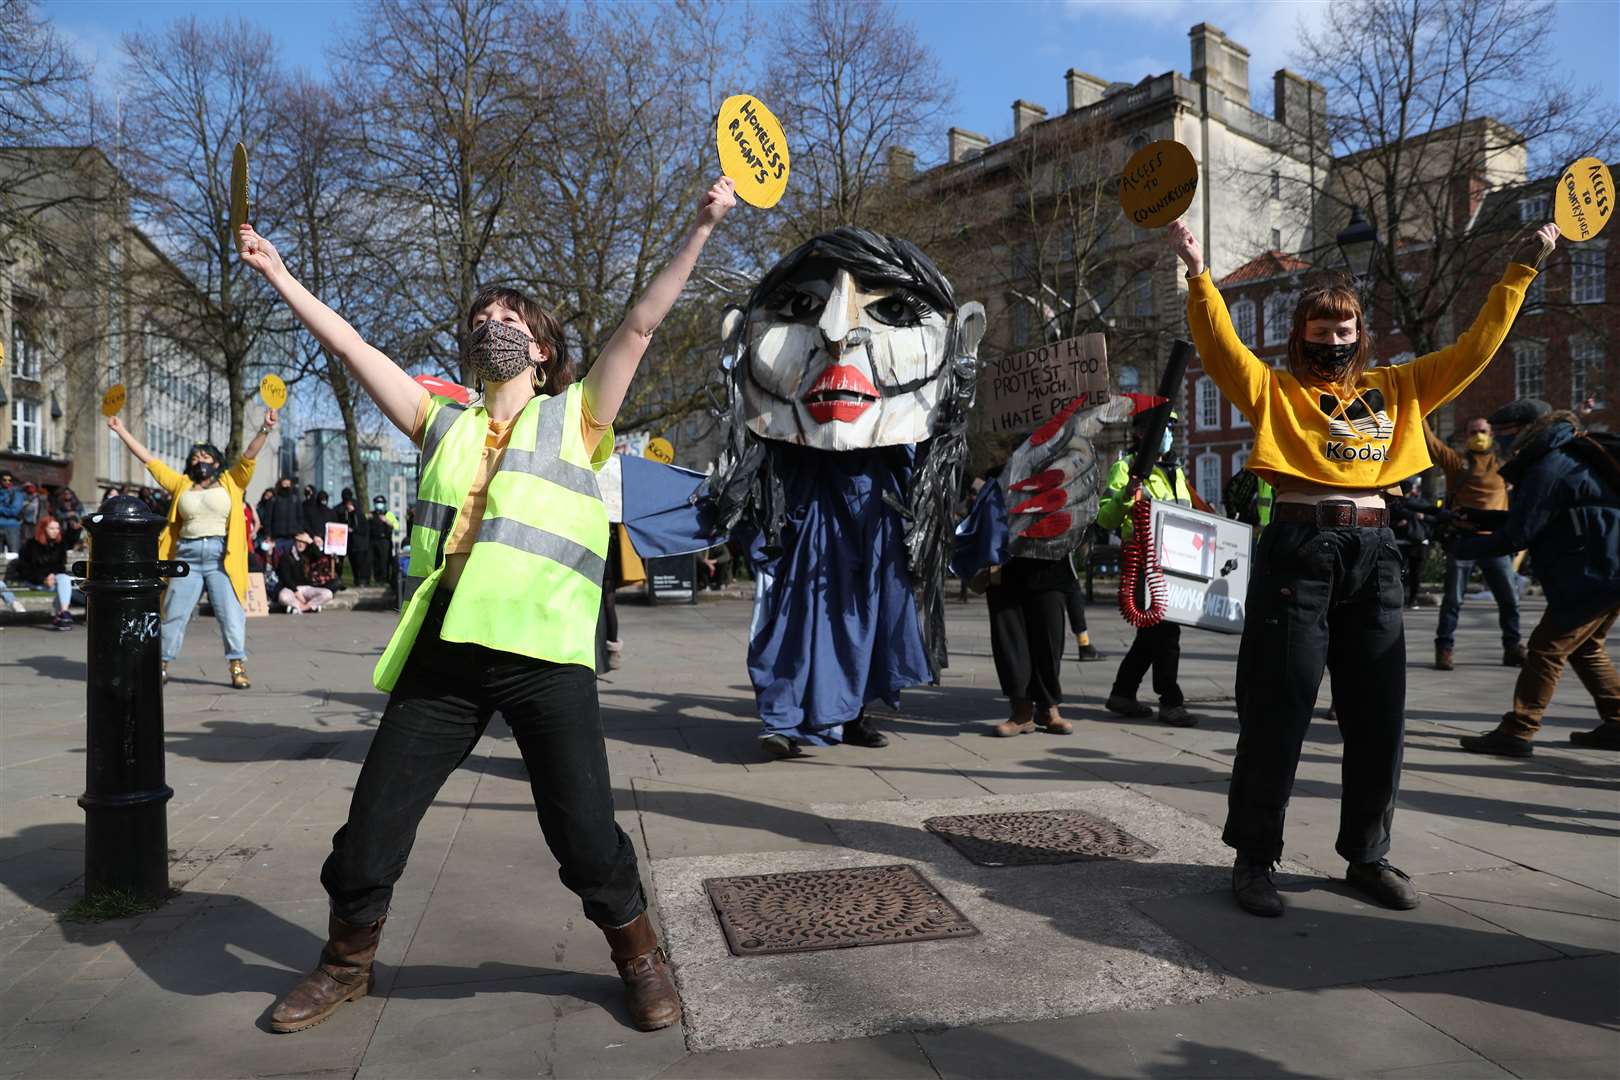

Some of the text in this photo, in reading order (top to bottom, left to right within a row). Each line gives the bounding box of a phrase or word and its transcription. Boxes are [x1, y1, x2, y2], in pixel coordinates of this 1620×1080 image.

[728, 118, 769, 184] RIGHTS
[740, 100, 786, 179] HOMELESS
[1122, 151, 1165, 193] ACCESS
[1143, 178, 1159, 192] TO
[1588, 165, 1609, 217] ACCESS
[1564, 173, 1590, 239] COUNTRYSIDE
[1582, 191, 1592, 205] TO
[992, 341, 1079, 376] YOU DOTH
[993, 358, 1099, 400] PROTEST TOO
[1027, 380, 1072, 401] MUCH.
[992, 418, 998, 432] I
[1001, 404, 1043, 430] HATE
